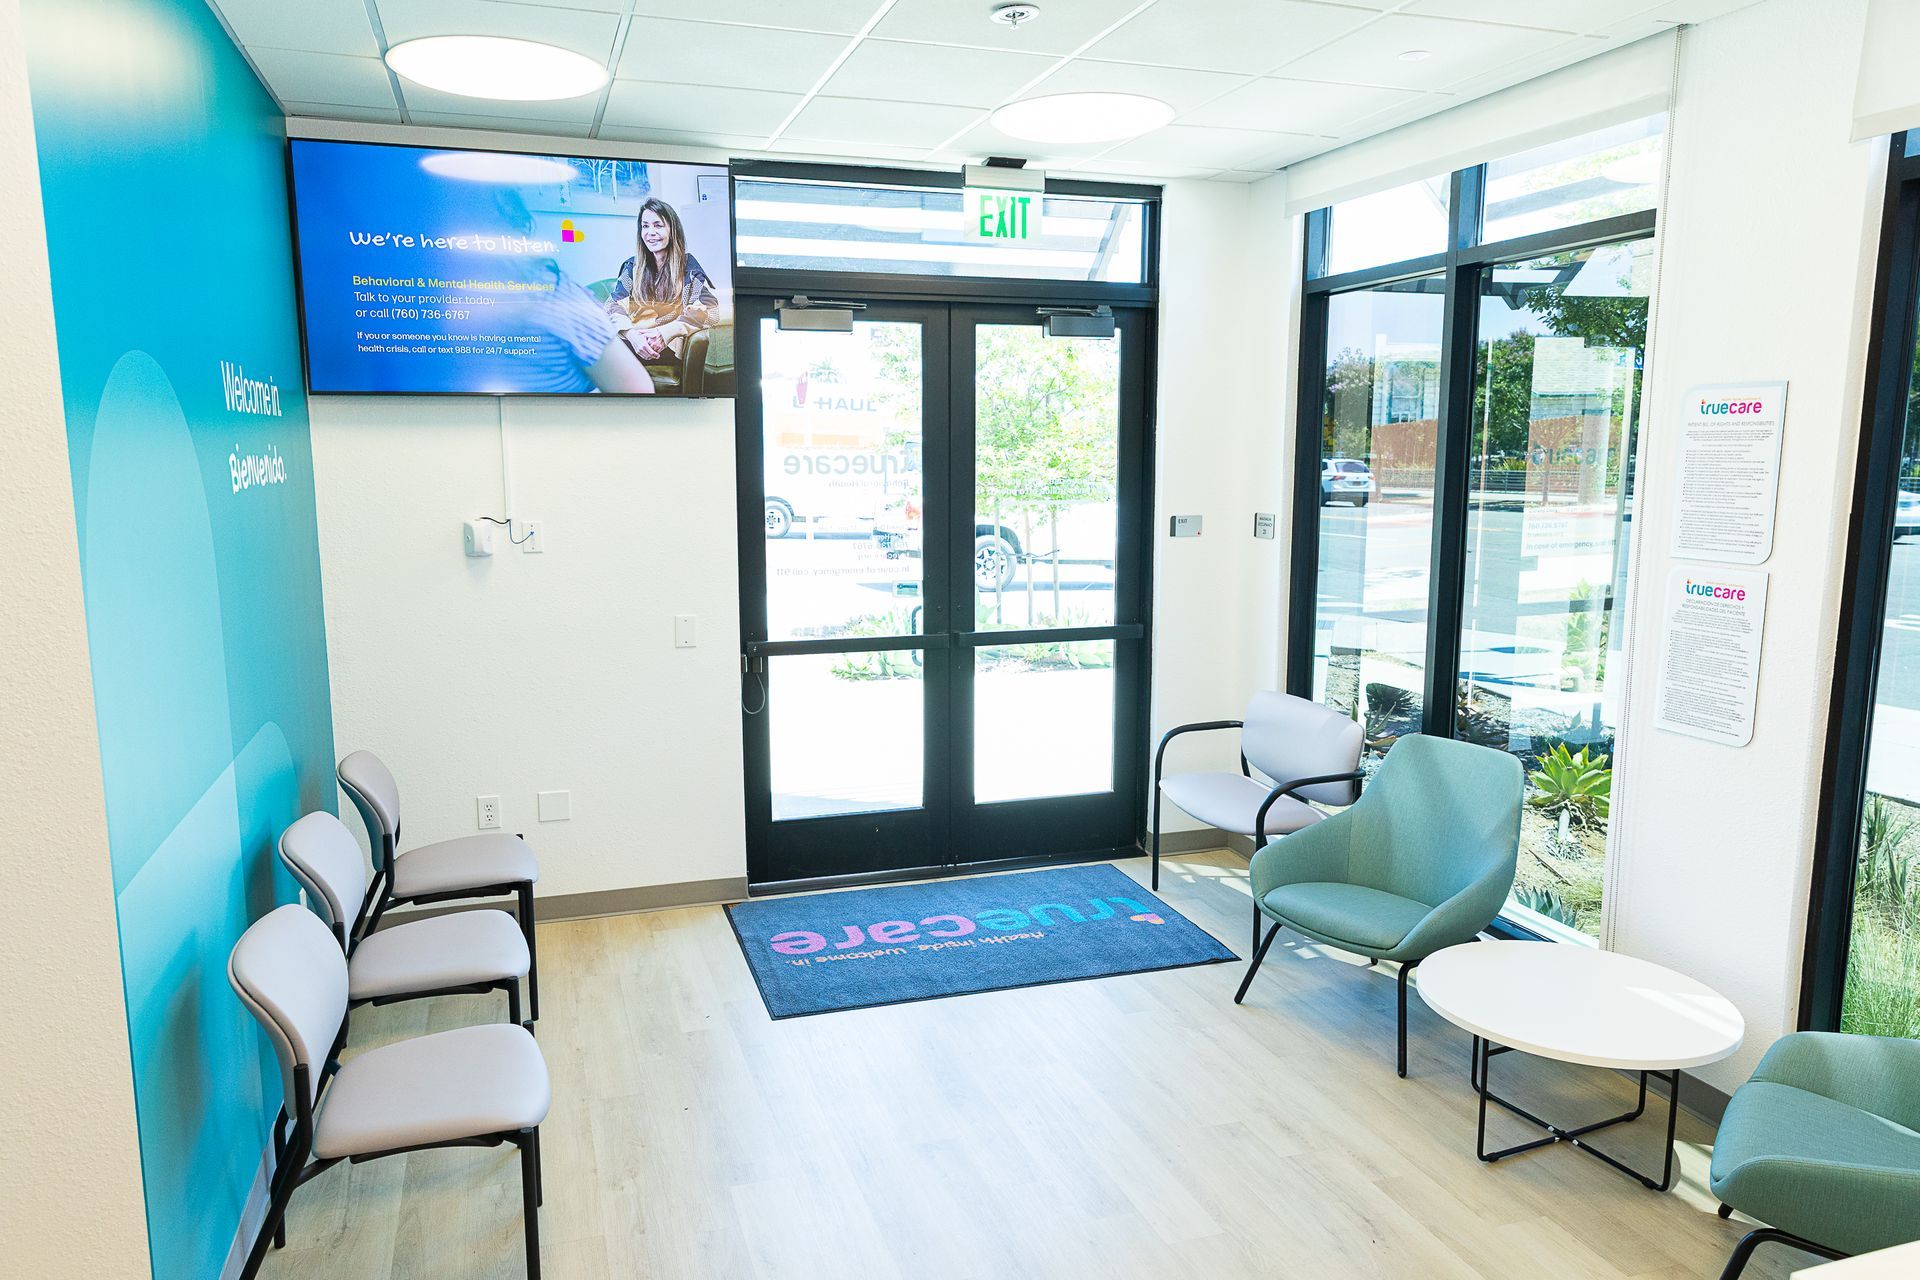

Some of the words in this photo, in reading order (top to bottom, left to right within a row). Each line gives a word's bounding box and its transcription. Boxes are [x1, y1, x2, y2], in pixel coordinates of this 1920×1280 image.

[980, 195, 1030, 239] EXIT
[349, 231, 415, 248] We're
[420, 233, 468, 249] here
[470, 235, 496, 250] to
[501, 235, 560, 254] listen.
[352, 276, 414, 287] Behavioral
[417, 278, 426, 288] &
[428, 278, 466, 289] Mental
[469, 279, 505, 290] Health
[507, 281, 555, 292] Services
[353, 291, 376, 303] Talk
[377, 293, 390, 303] to
[391, 295, 416, 306] your
[418, 294, 463, 306] provider
[465, 295, 496, 307] today
[355, 309, 367, 318] or
[369, 308, 390, 318] call
[391, 308, 419, 320] (760)
[420, 309, 470, 320] 736-6767
[356, 331, 363, 340] If
[364, 333, 381, 343] you
[381, 332, 391, 340] or
[391, 333, 431, 341] someone
[432, 334, 448, 343] you
[448, 333, 470, 341] know
[470, 333, 478, 341] is
[479, 333, 506, 343] having
[358, 344, 385, 353] health
[386, 345, 411, 354] crisis,
[411, 345, 427, 353] call
[438, 346, 453, 354] text
[454, 346, 471, 354] 988
[472, 346, 484, 354] for
[485, 346, 503, 355] 24/7
[503, 347, 537, 356] support.
[220, 360, 271, 416] Welcome
[270, 376, 282, 417] in.
[1700, 399, 1762, 415] truecare
[229, 443, 287, 495] Bienvenido.
[1686, 579, 1746, 601] truecare
[770, 897, 1152, 955] truecare
[978, 931, 1045, 944] Health
[814, 947, 908, 963] Welcome
